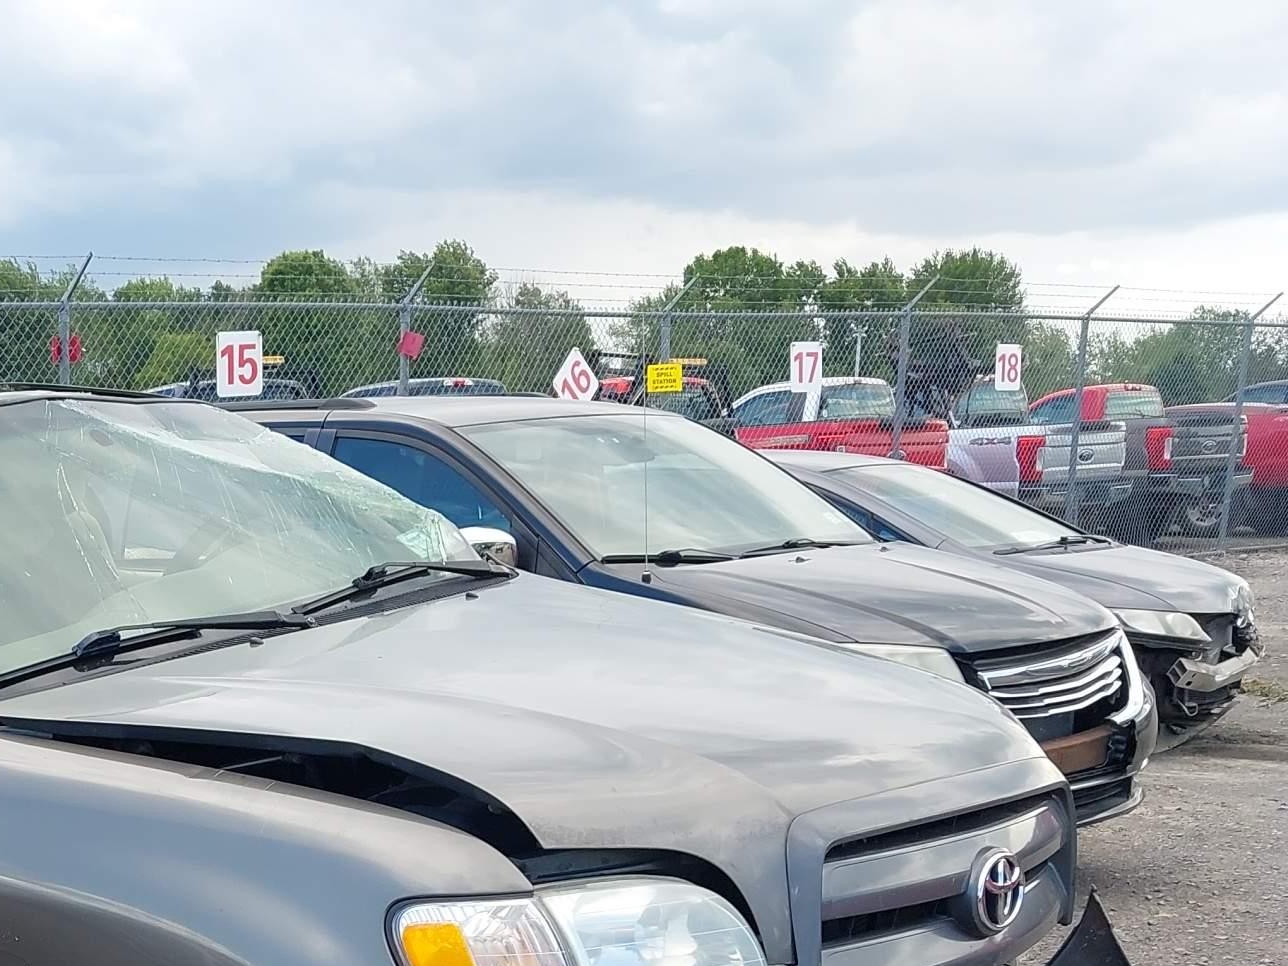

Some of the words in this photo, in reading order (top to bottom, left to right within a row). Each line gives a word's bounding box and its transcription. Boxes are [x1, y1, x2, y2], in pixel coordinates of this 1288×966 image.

[221, 344, 258, 385] 15
[561, 360, 591, 400] 16
[794, 352, 819, 383] 17
[998, 353, 1018, 383] 18
